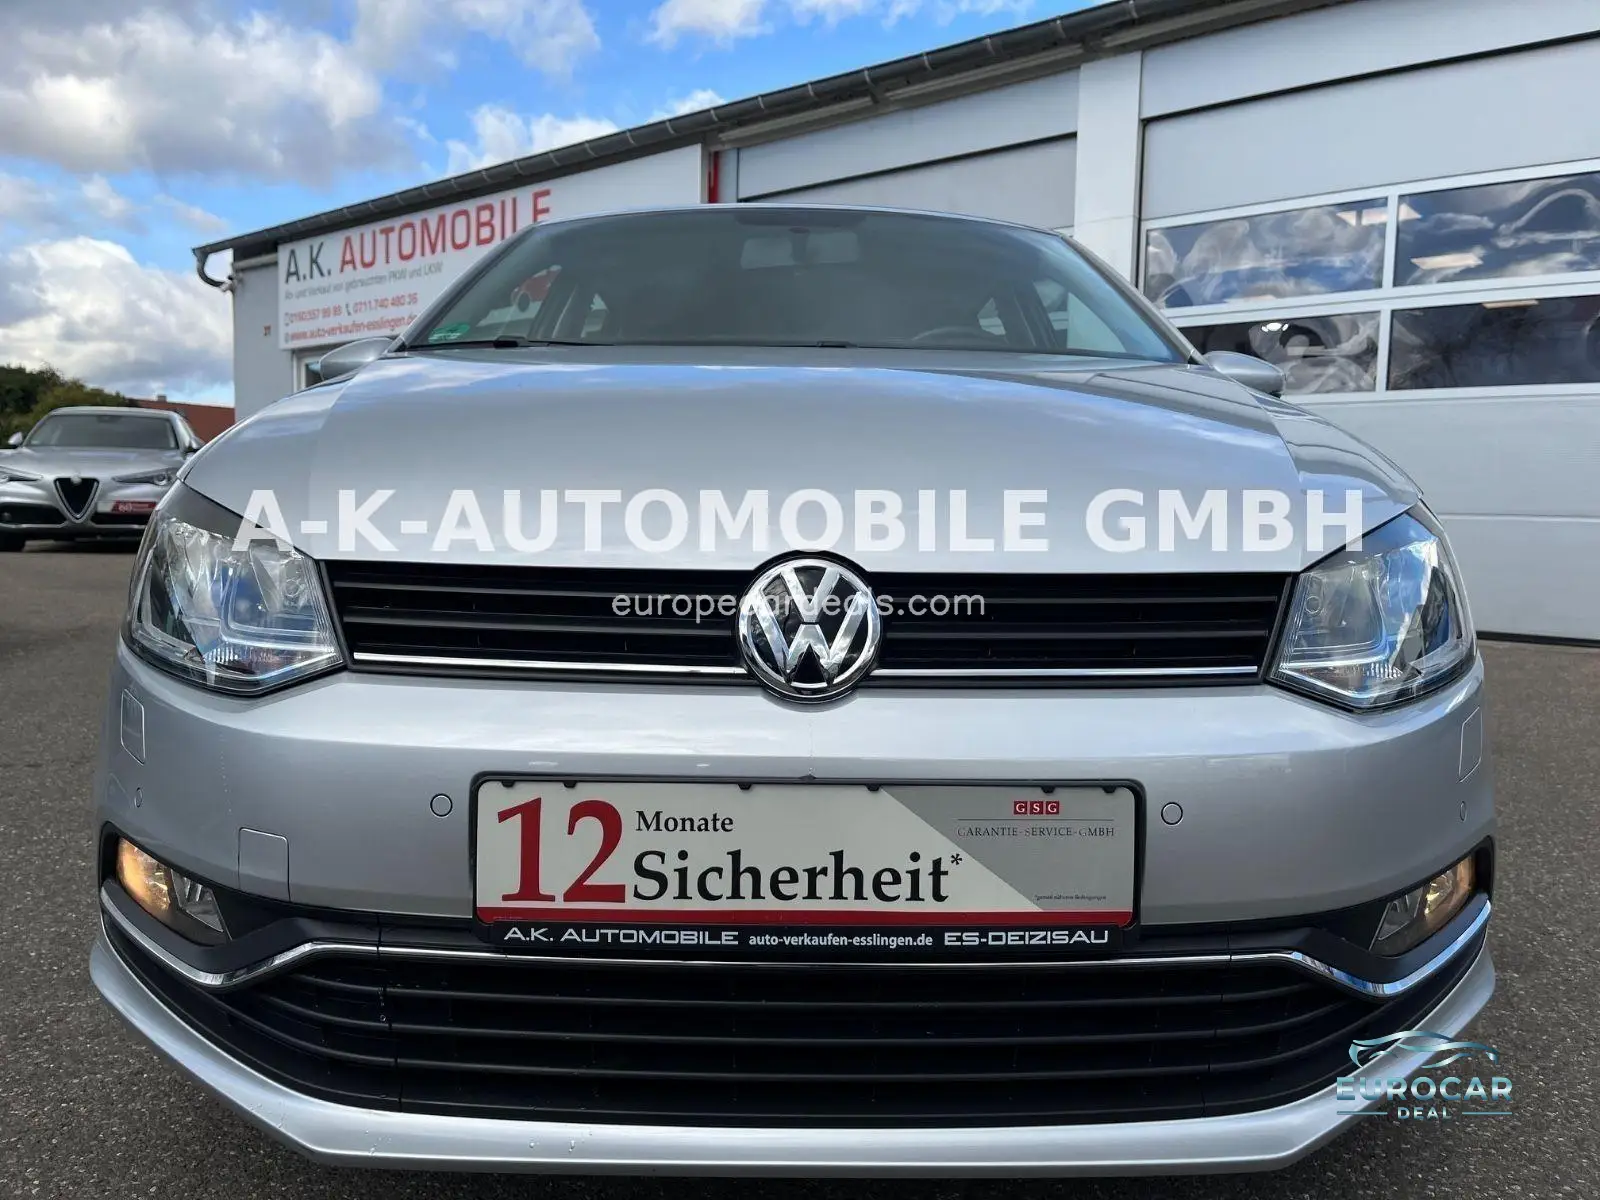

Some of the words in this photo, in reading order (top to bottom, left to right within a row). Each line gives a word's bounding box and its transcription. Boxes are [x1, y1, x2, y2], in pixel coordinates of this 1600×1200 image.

[285, 240, 331, 284] A.K.
[389, 268, 407, 282] PKW
[408, 265, 422, 279] und
[424, 260, 444, 275] LKW
[1014, 800, 1060, 815] GSG
[497, 797, 626, 904] 12
[635, 810, 734, 832] Monate
[504, 927, 553, 942] A.K.
[560, 928, 739, 945] AUTOMOBILE
[749, 933, 933, 948] auto-verkaufen-esslingen.de
[944, 930, 1109, 946] ES-DEIZISAU
